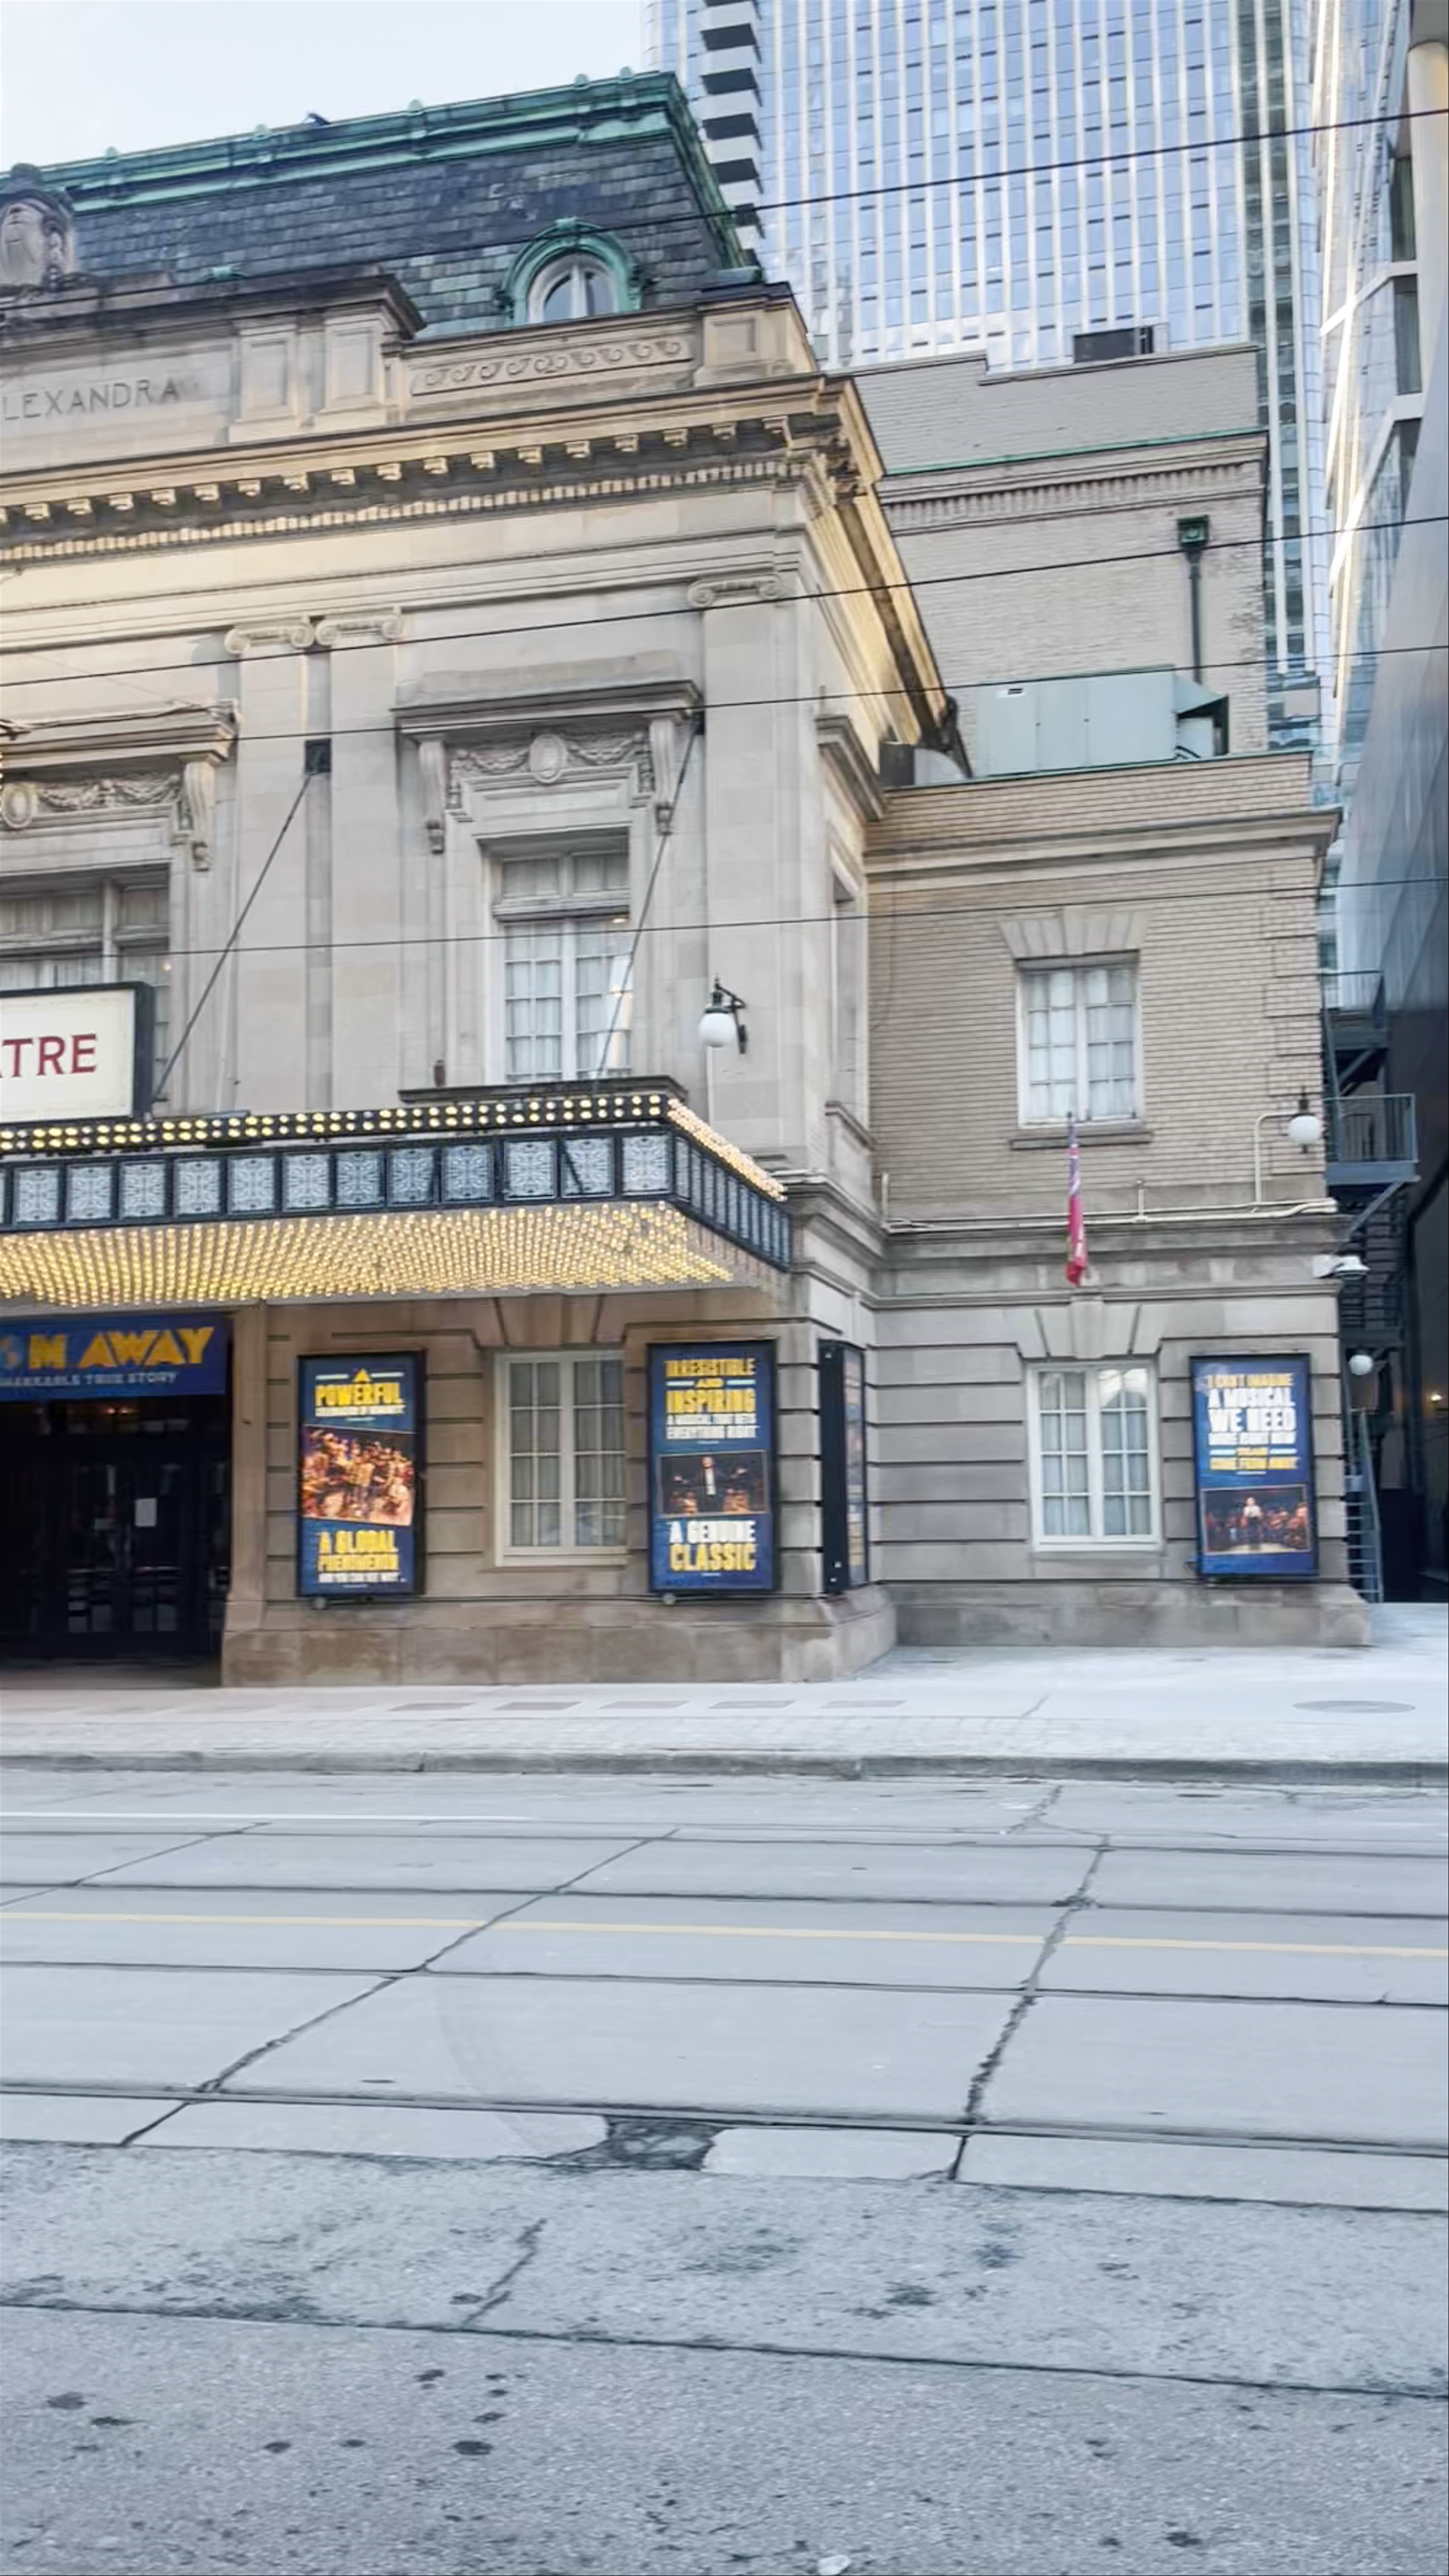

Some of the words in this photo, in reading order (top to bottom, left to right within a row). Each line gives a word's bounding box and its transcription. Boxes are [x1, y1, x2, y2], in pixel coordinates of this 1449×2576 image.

[2, 378, 180, 420] LEXANDRA
[0, 1033, 97, 1078] TRE
[78, 1327, 214, 1368] AWAY
[315, 1383, 404, 1407] POWERFUL
[666, 1388, 756, 1413] INSPIRING
[1223, 1387, 1296, 1408] MUSICAL
[1208, 1408, 1243, 1432] WE
[1246, 1407, 1297, 1432] NEED
[334, 1530, 399, 1554] GLOBAL
[670, 1543, 757, 1572] CLASSIC
